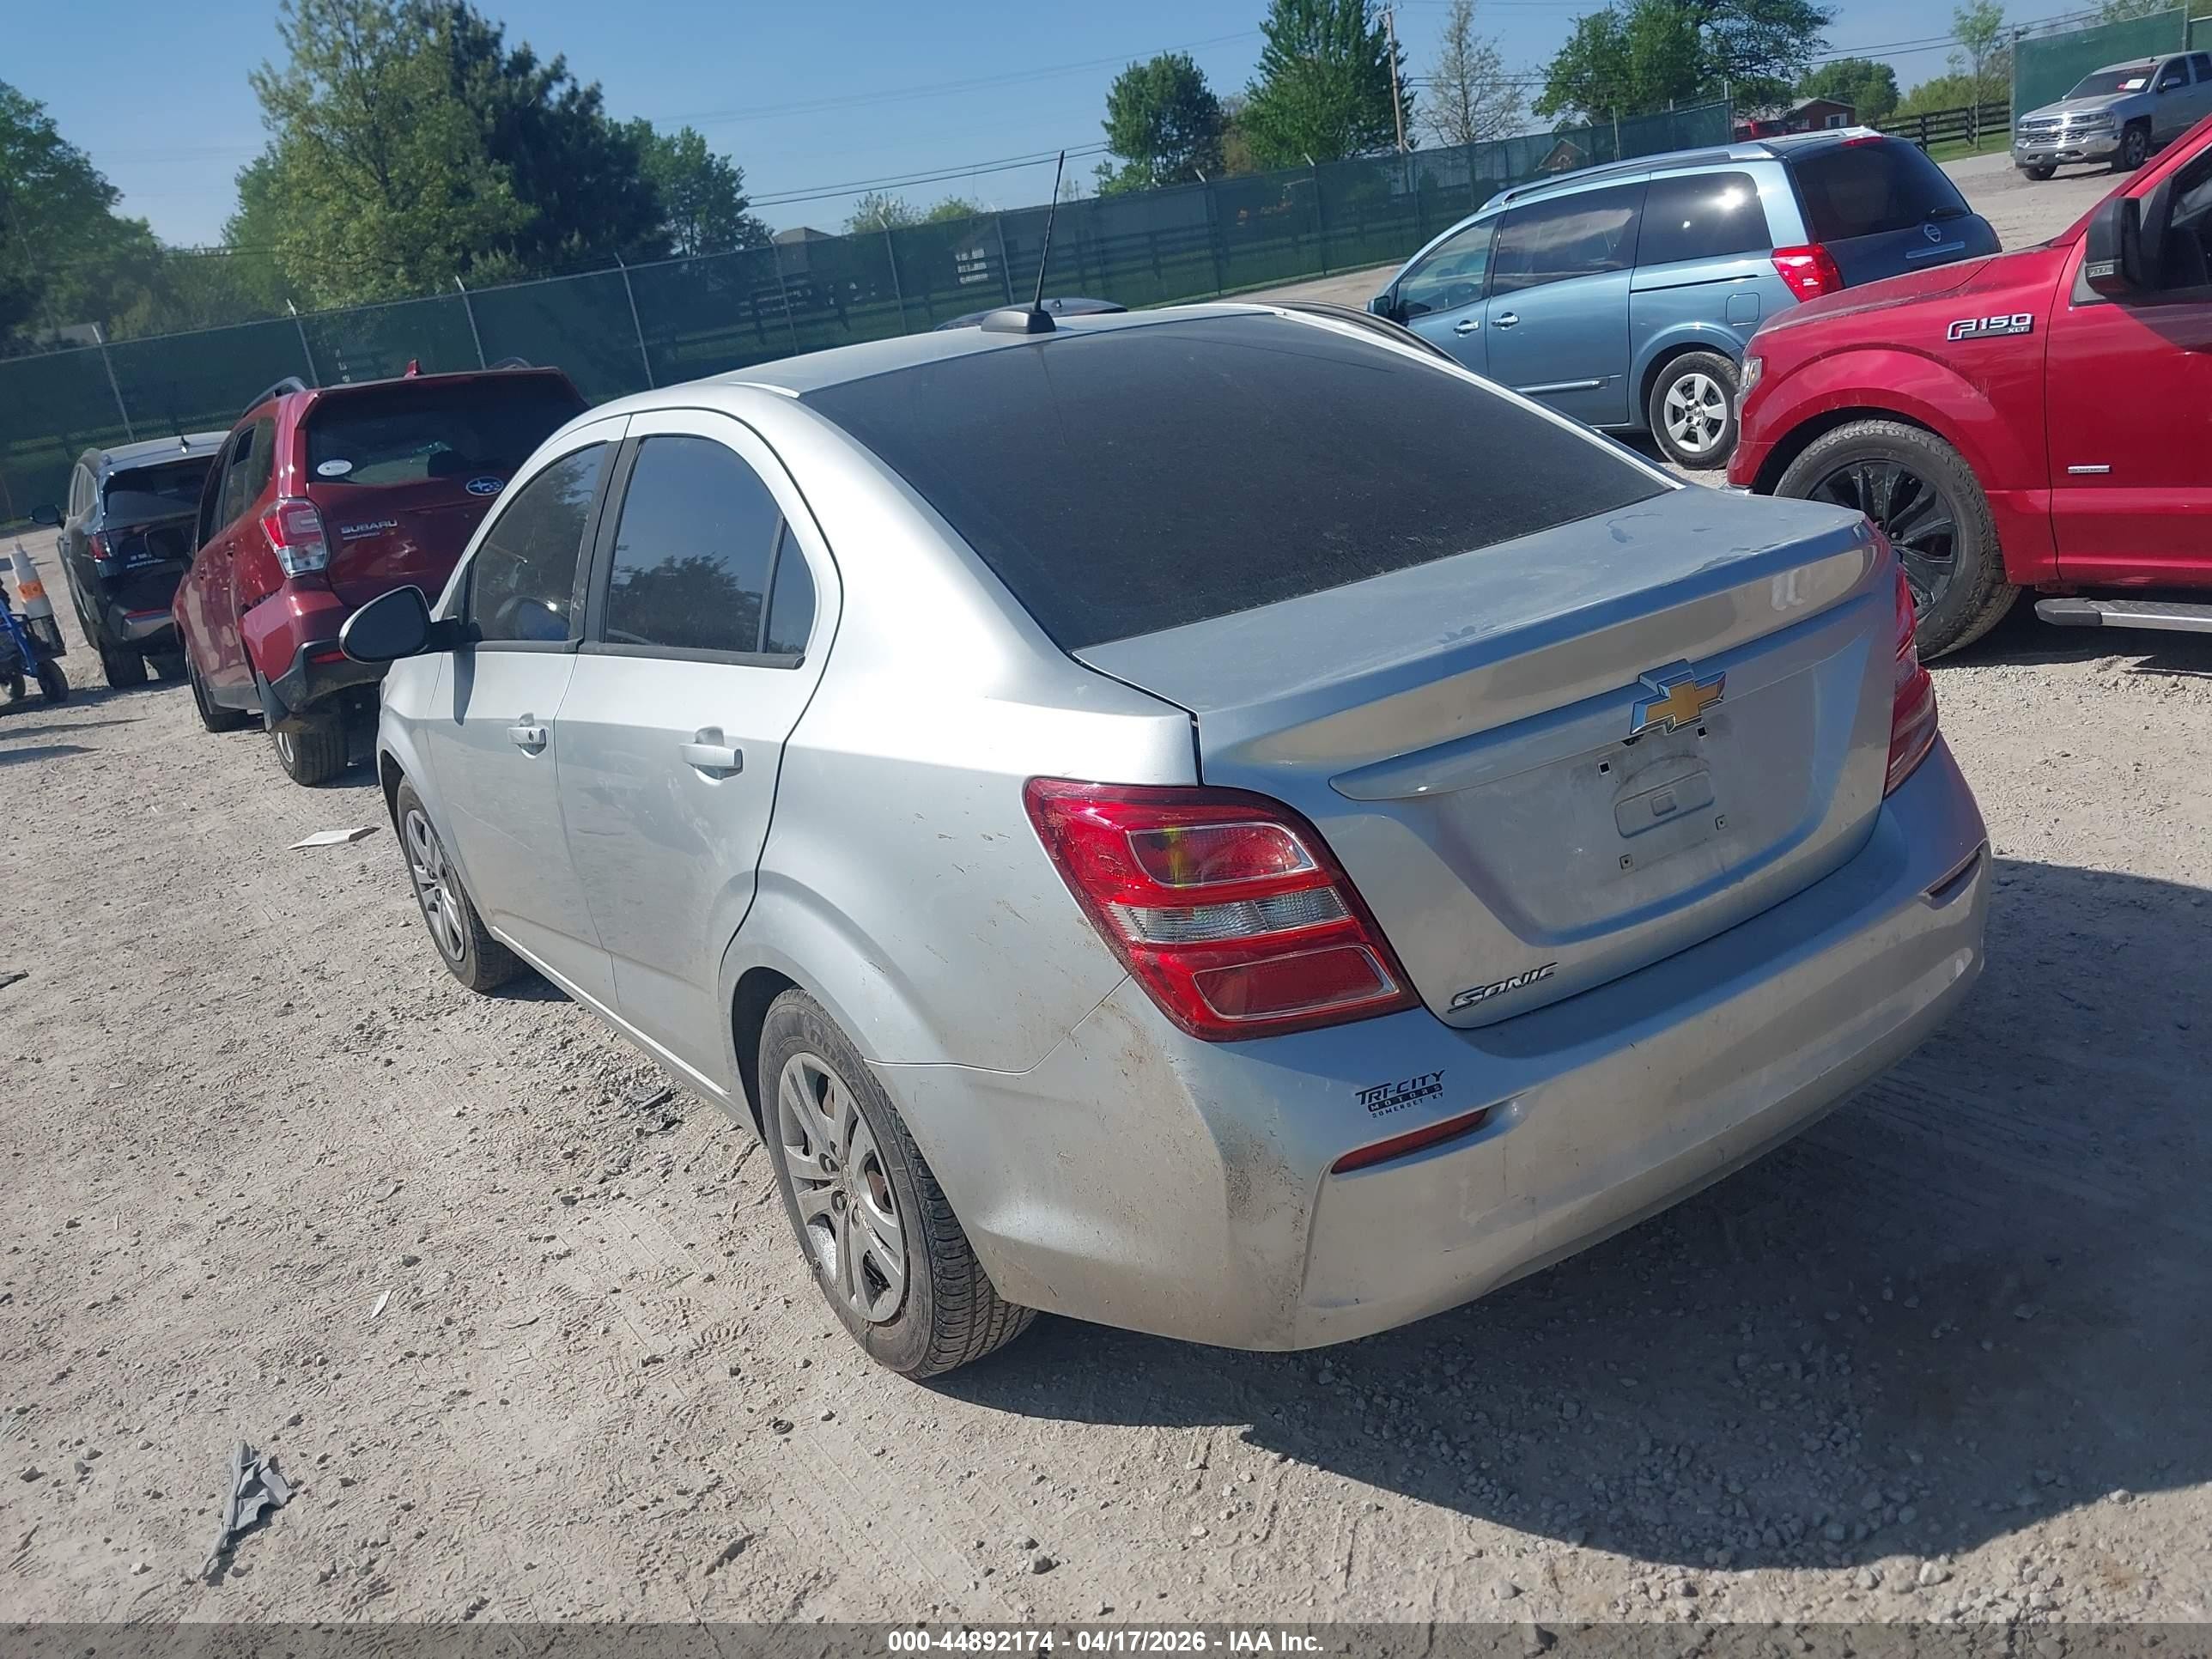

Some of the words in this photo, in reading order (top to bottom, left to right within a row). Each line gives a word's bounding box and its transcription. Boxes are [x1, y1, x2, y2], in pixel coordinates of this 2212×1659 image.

[341, 520, 398, 534] SUBARU
[1448, 962, 1559, 1014] SONIC
[1355, 1069, 1446, 1106] TRI-CITY
[1369, 1085, 1442, 1111] MOTORS
[1371, 1098, 1424, 1119] SOMERSET
[1431, 1091, 1443, 1100] KY
